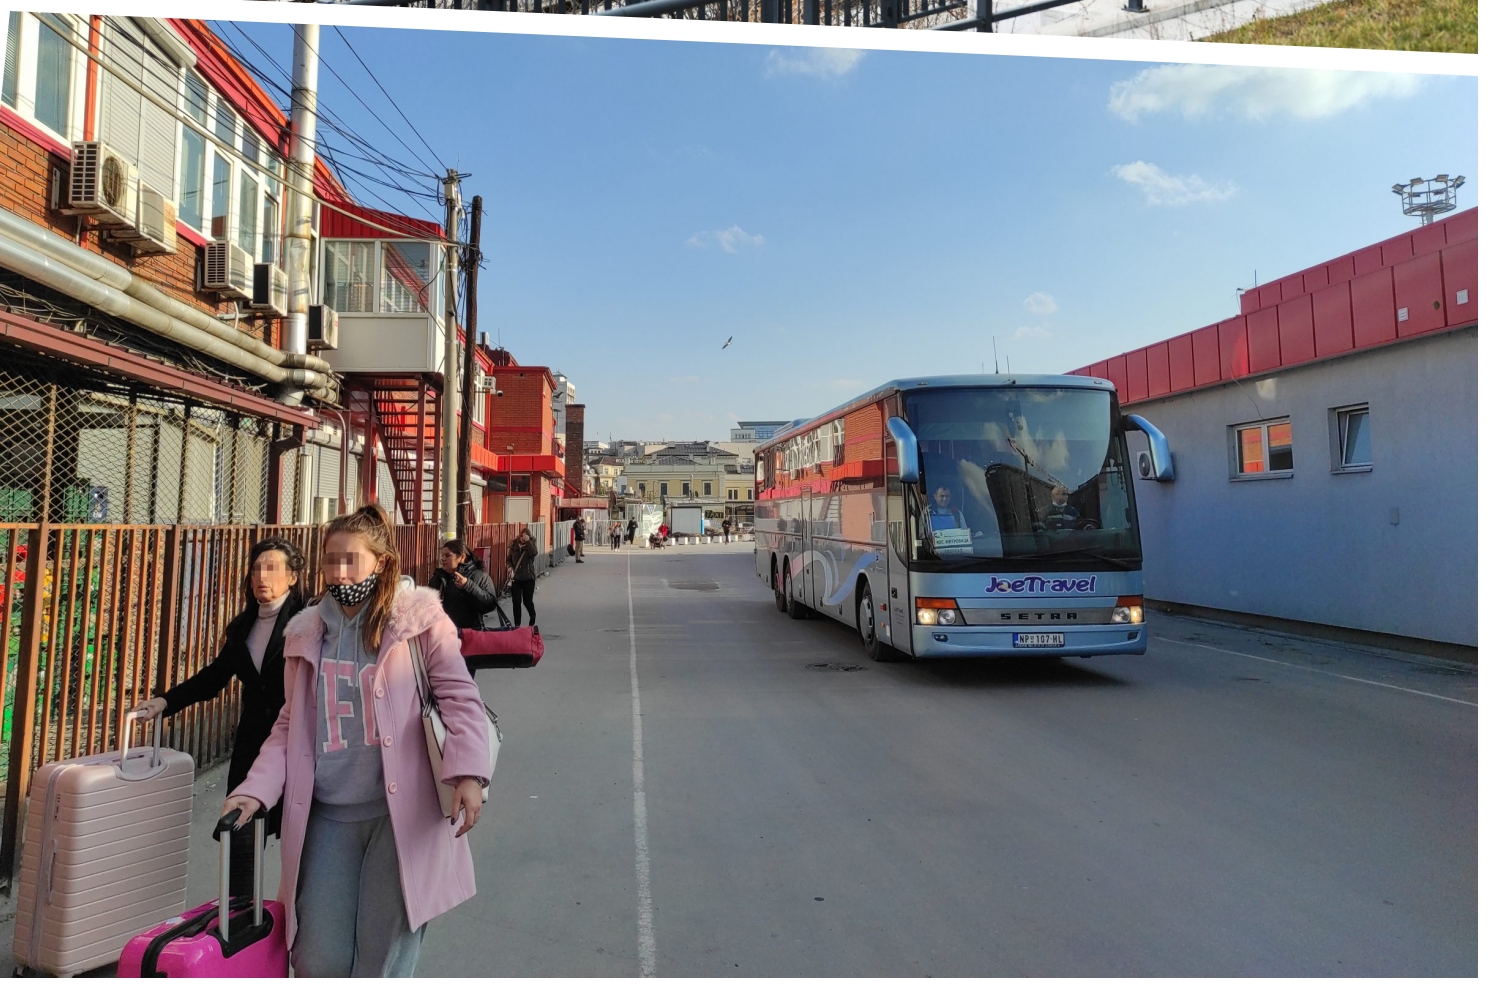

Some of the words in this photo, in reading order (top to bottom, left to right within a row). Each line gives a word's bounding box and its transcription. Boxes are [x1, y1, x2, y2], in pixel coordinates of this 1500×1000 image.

[705, 510, 723, 518] TAXI
[985, 575, 1097, 593] JoeTravel
[1000, 612, 1077, 620] SETRA
[1019, 634, 1029, 644] NP
